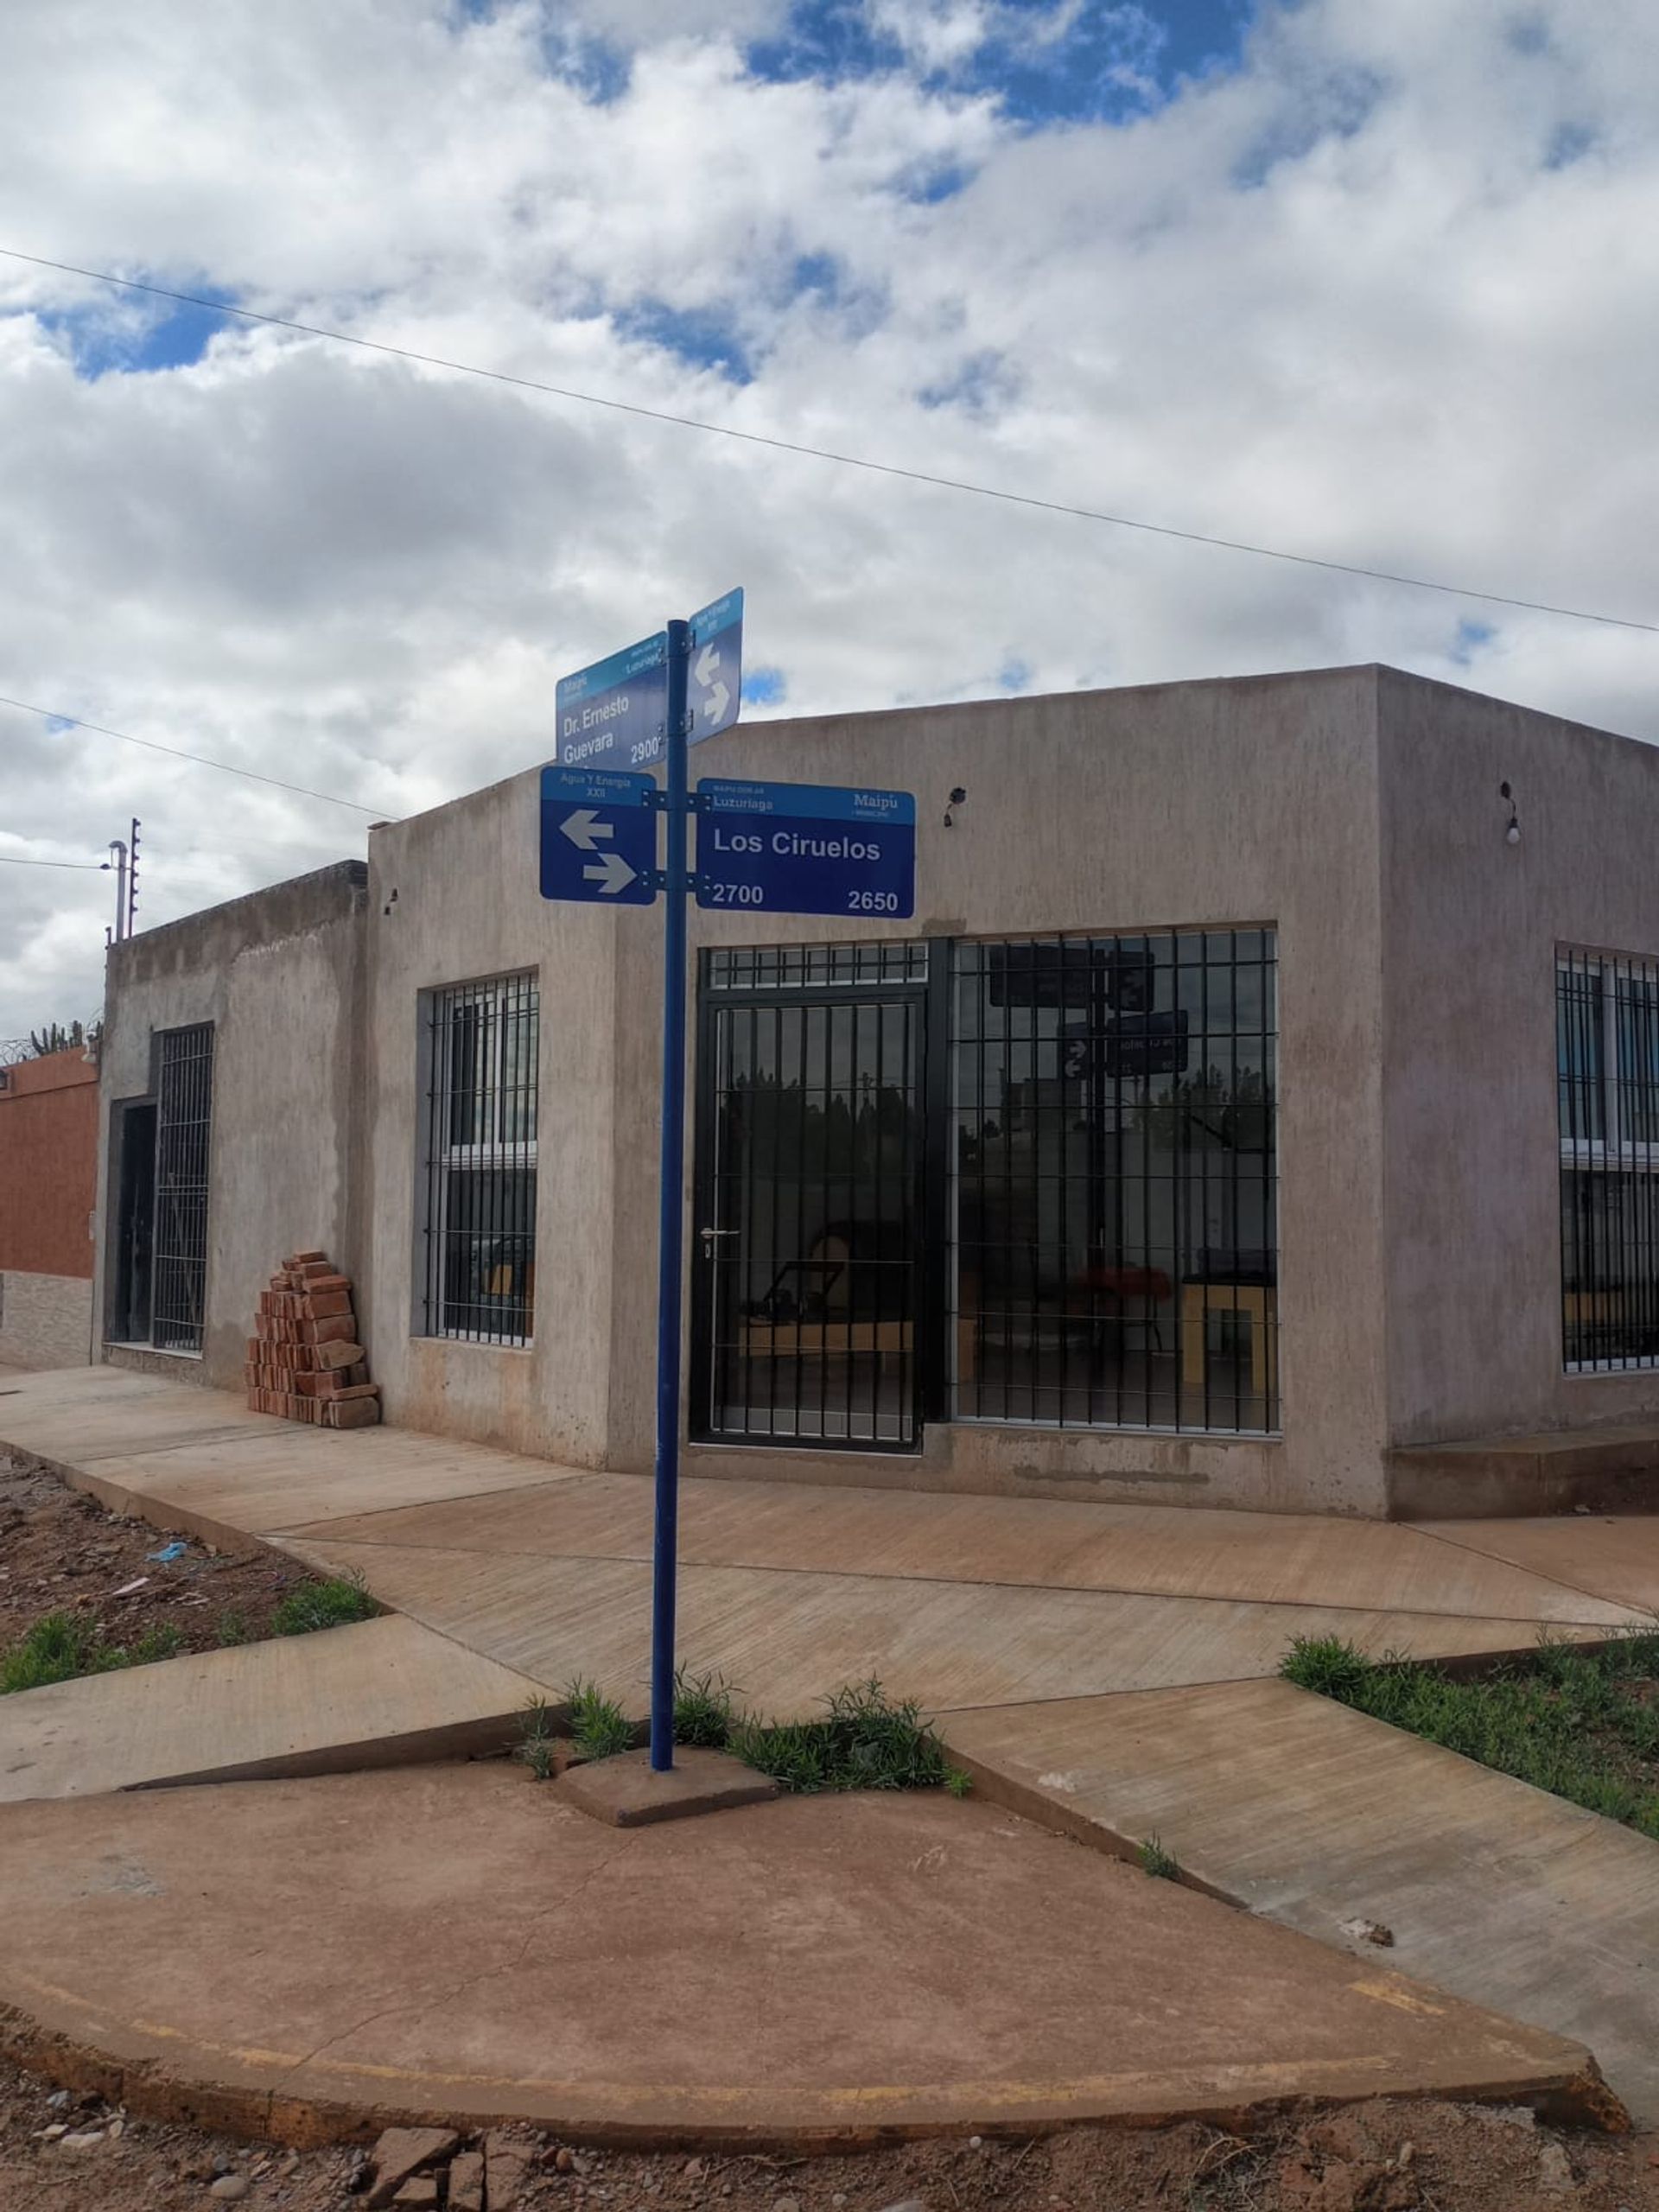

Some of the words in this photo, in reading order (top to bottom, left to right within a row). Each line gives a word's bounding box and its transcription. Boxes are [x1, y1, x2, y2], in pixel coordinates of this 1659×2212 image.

[563, 715, 580, 737] Dr.
[582, 696, 629, 728] Ernesto
[563, 734, 614, 765] Guevara
[631, 739, 660, 764] 2900
[713, 794, 773, 812] Luzuriaga
[854, 792, 899, 811] Maipú
[714, 828, 763, 853] Los
[772, 831, 881, 861] Ciruelos
[712, 883, 764, 906] 2700
[848, 890, 899, 912] 2650
